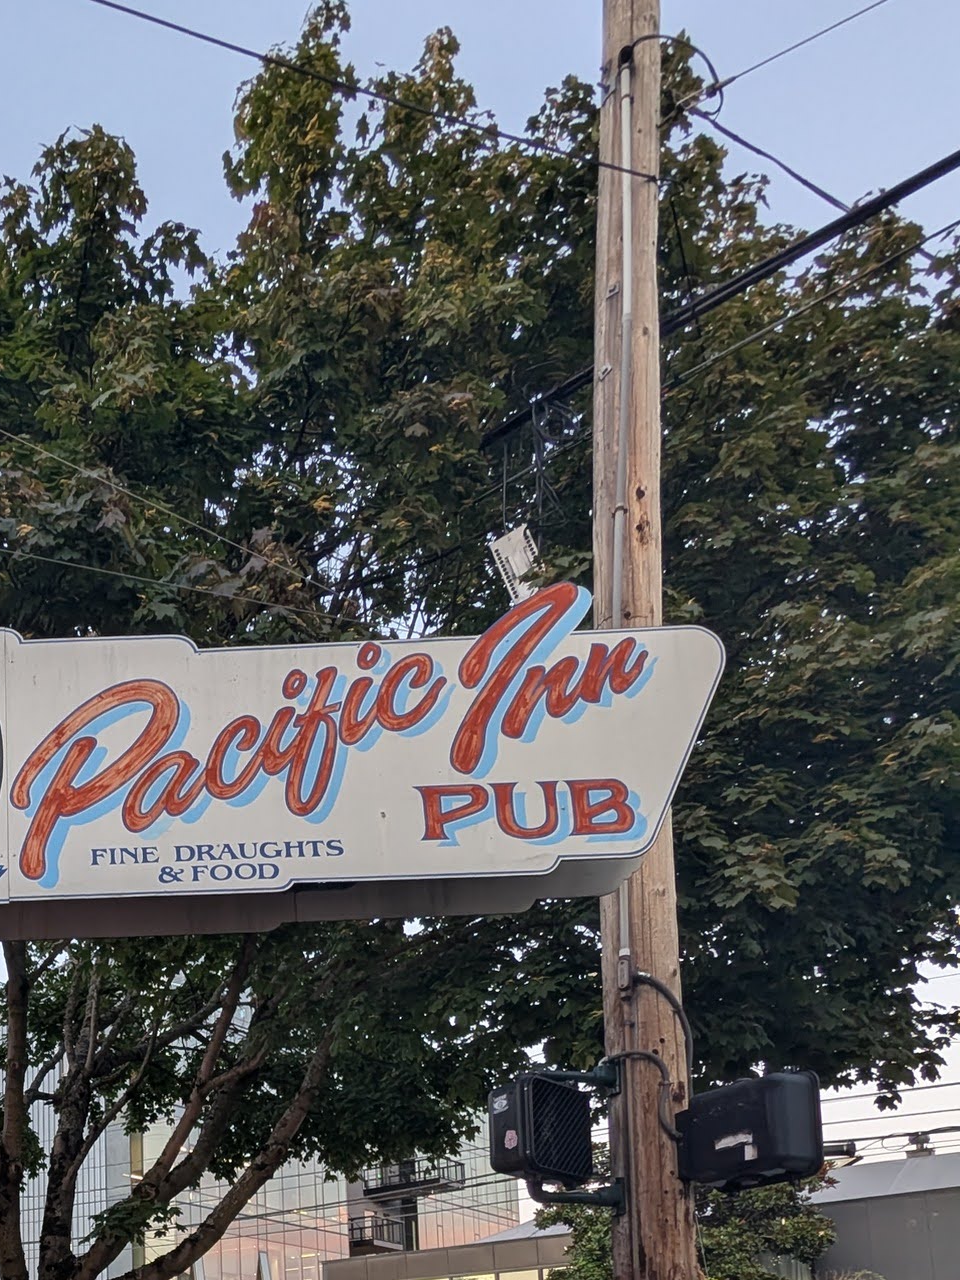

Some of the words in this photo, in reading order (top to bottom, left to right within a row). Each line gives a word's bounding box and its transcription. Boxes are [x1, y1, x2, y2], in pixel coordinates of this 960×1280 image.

[11, 642, 447, 881] Pacific
[450, 581, 649, 775] Inn
[414, 778, 637, 842] PUB
[90, 846, 160, 866] FINE
[174, 839, 345, 862] DRAUGHTS
[158, 866, 185, 884] &
[191, 863, 280, 882] FOOD
